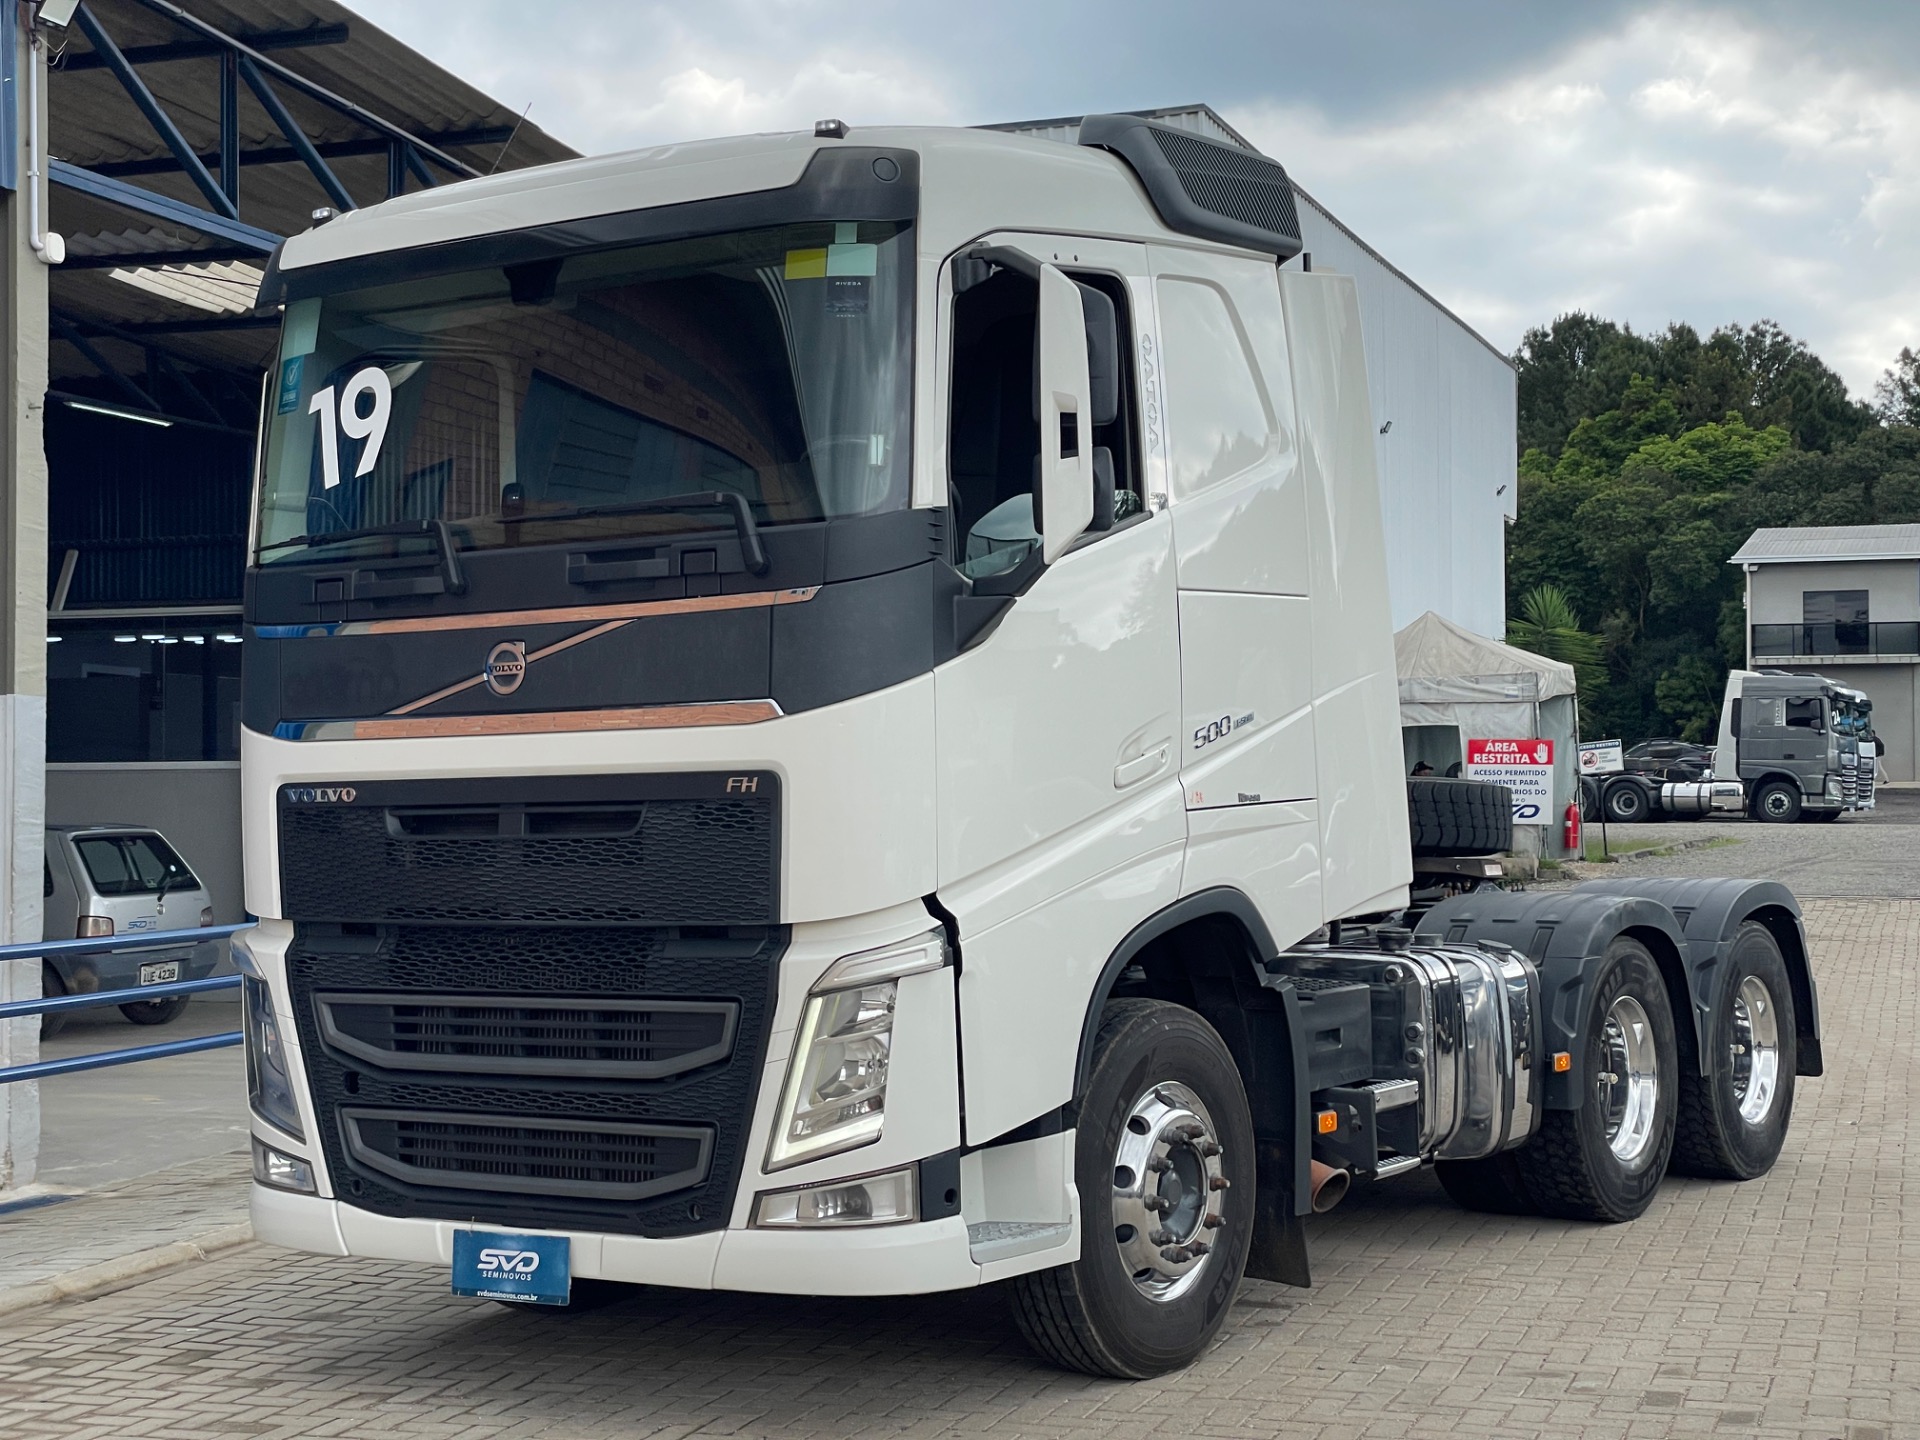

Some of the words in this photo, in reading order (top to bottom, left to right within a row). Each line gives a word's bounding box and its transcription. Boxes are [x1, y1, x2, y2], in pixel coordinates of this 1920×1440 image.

[308, 366, 392, 490] 19
[489, 664, 522, 672] VOLVO
[1194, 715, 1231, 749] 500
[1485, 740, 1518, 752] ÁREA
[1473, 753, 1530, 763] RESTRITA
[726, 776, 758, 793] FH
[284, 787, 356, 803] VOLVO
[477, 1248, 540, 1273] SVD
[482, 1270, 532, 1281] SEMINOVOS
[477, 1289, 538, 1301] svdseminovos.com.br
